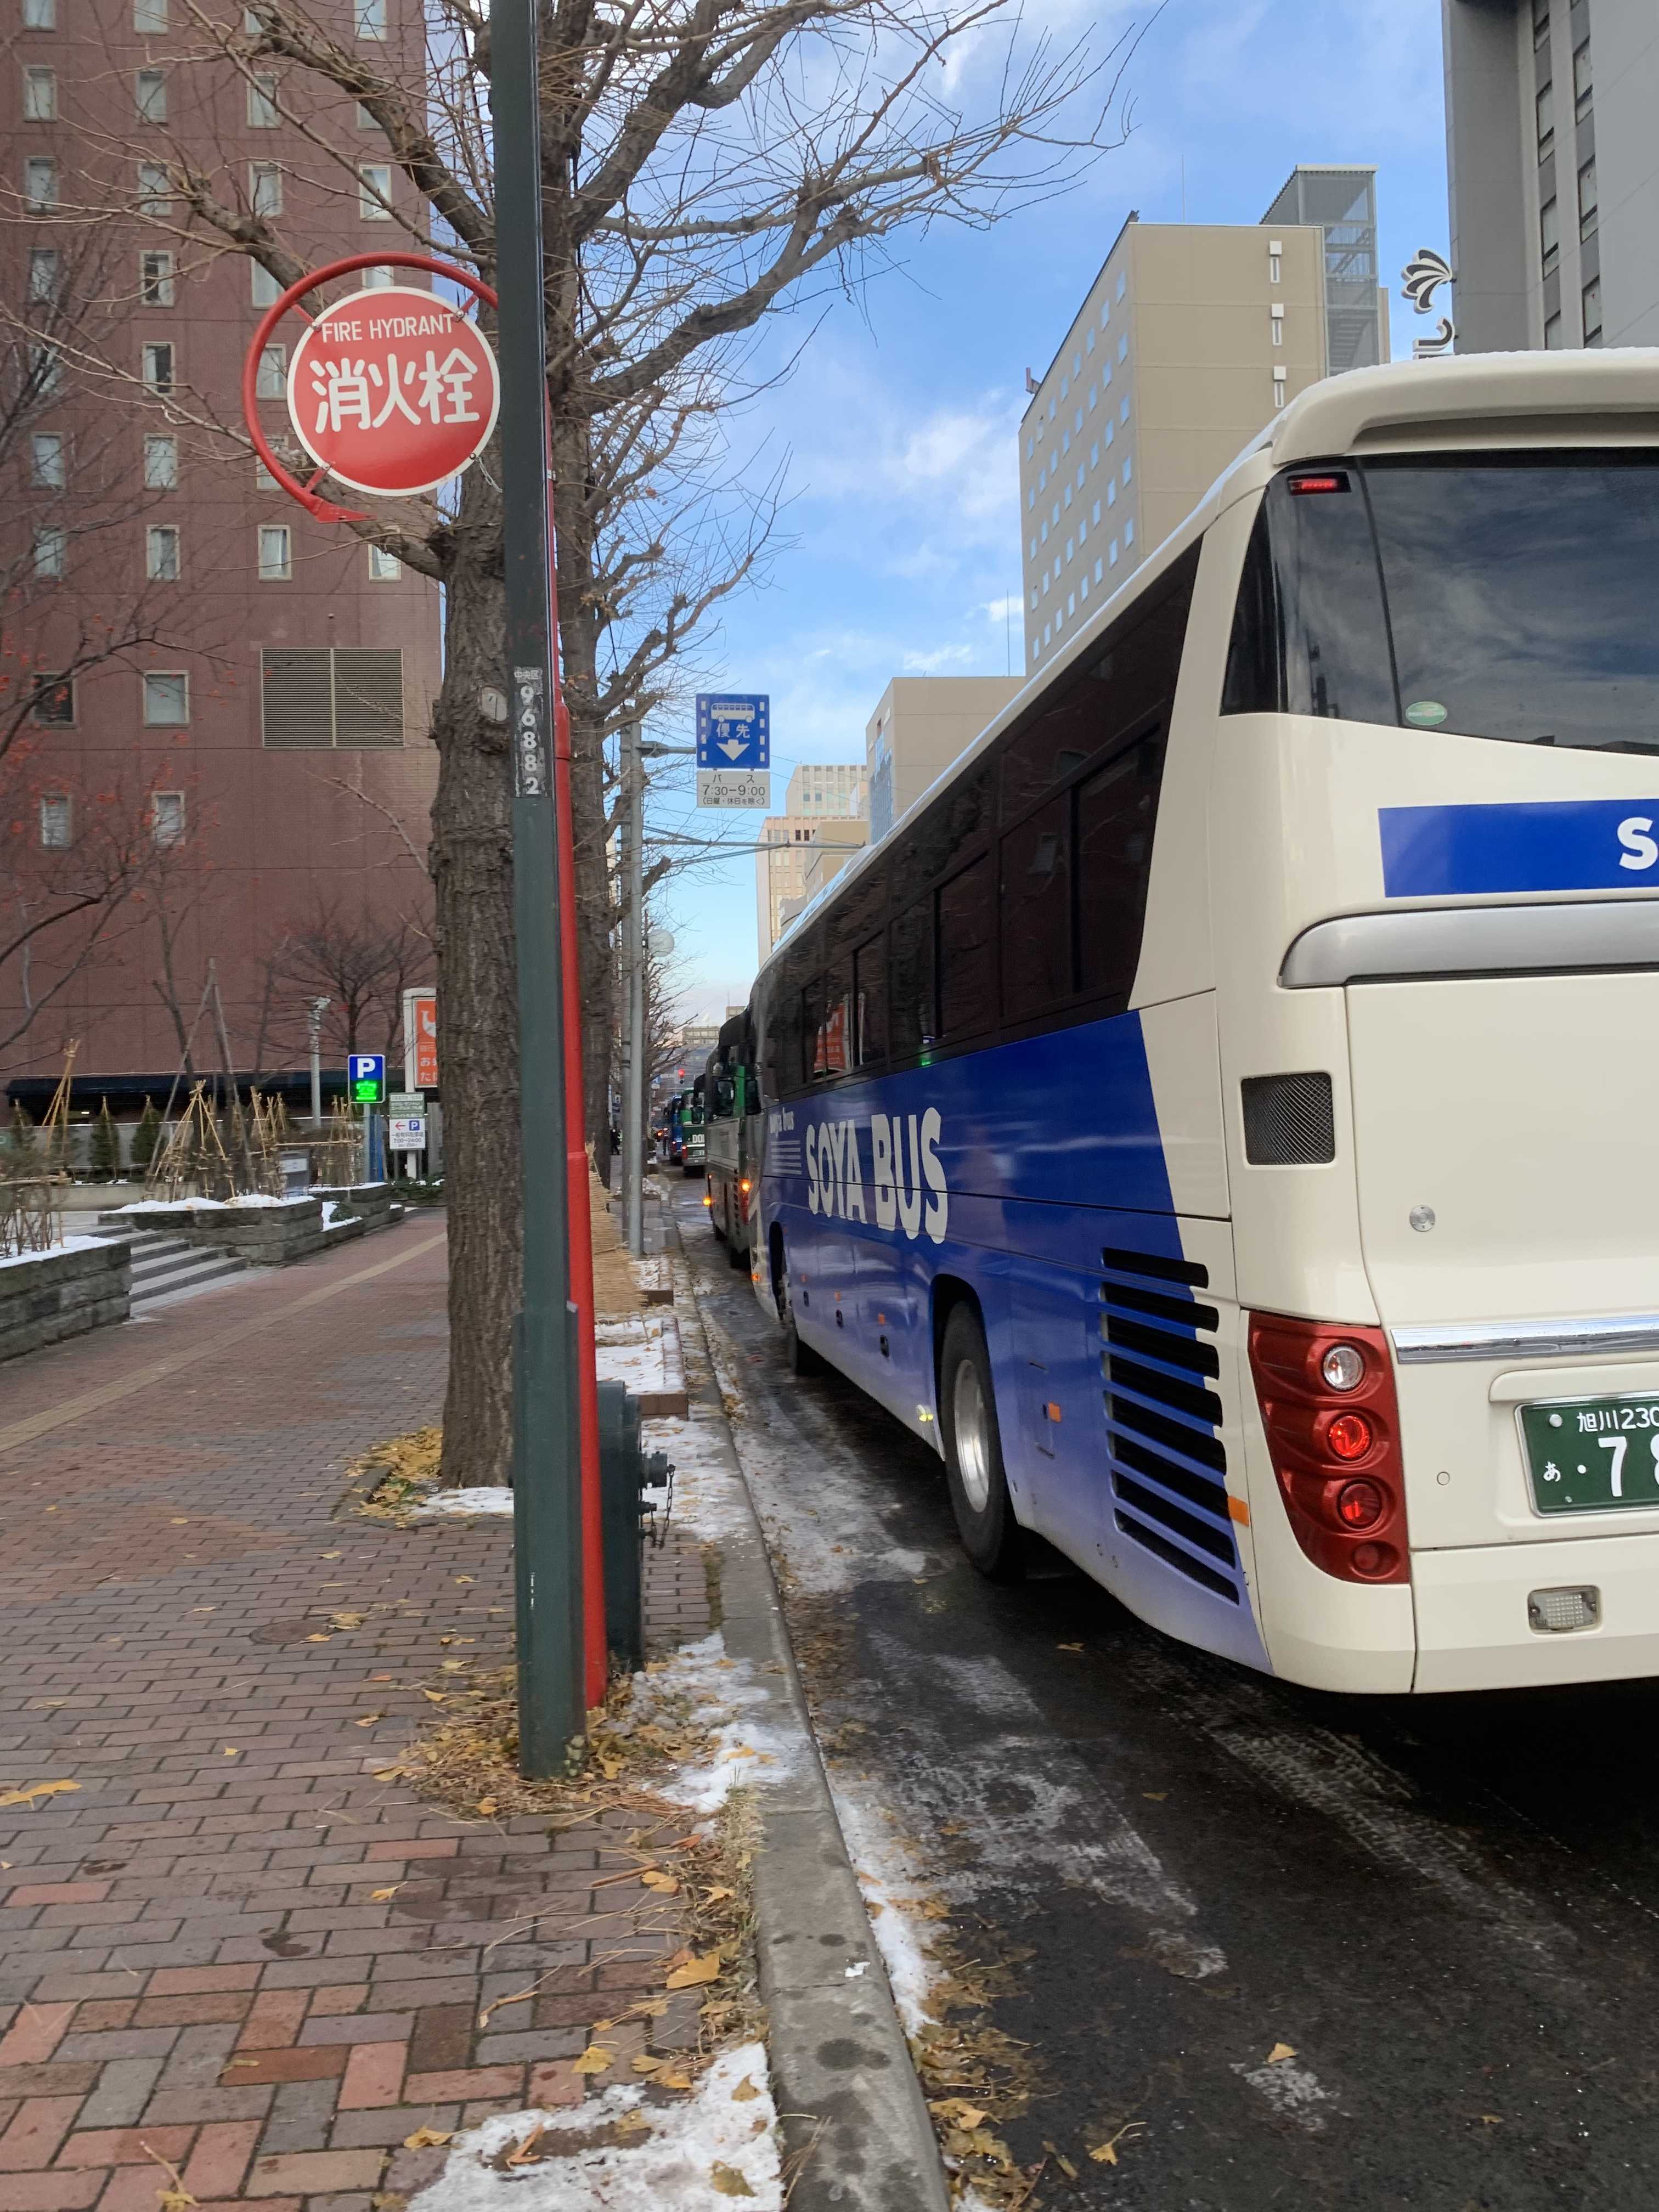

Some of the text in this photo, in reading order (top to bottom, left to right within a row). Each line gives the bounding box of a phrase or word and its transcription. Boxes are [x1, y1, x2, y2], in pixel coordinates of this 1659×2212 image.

[321, 313, 455, 343] FIRE HYDRANT
[309, 348, 480, 434] 消火栓
[520, 686, 540, 795] 96882
[716, 723, 751, 738] 優先
[357, 1058, 376, 1079] P
[806, 1107, 948, 1244] SOYA BUS
[1543, 1460, 1561, 1482] あ
